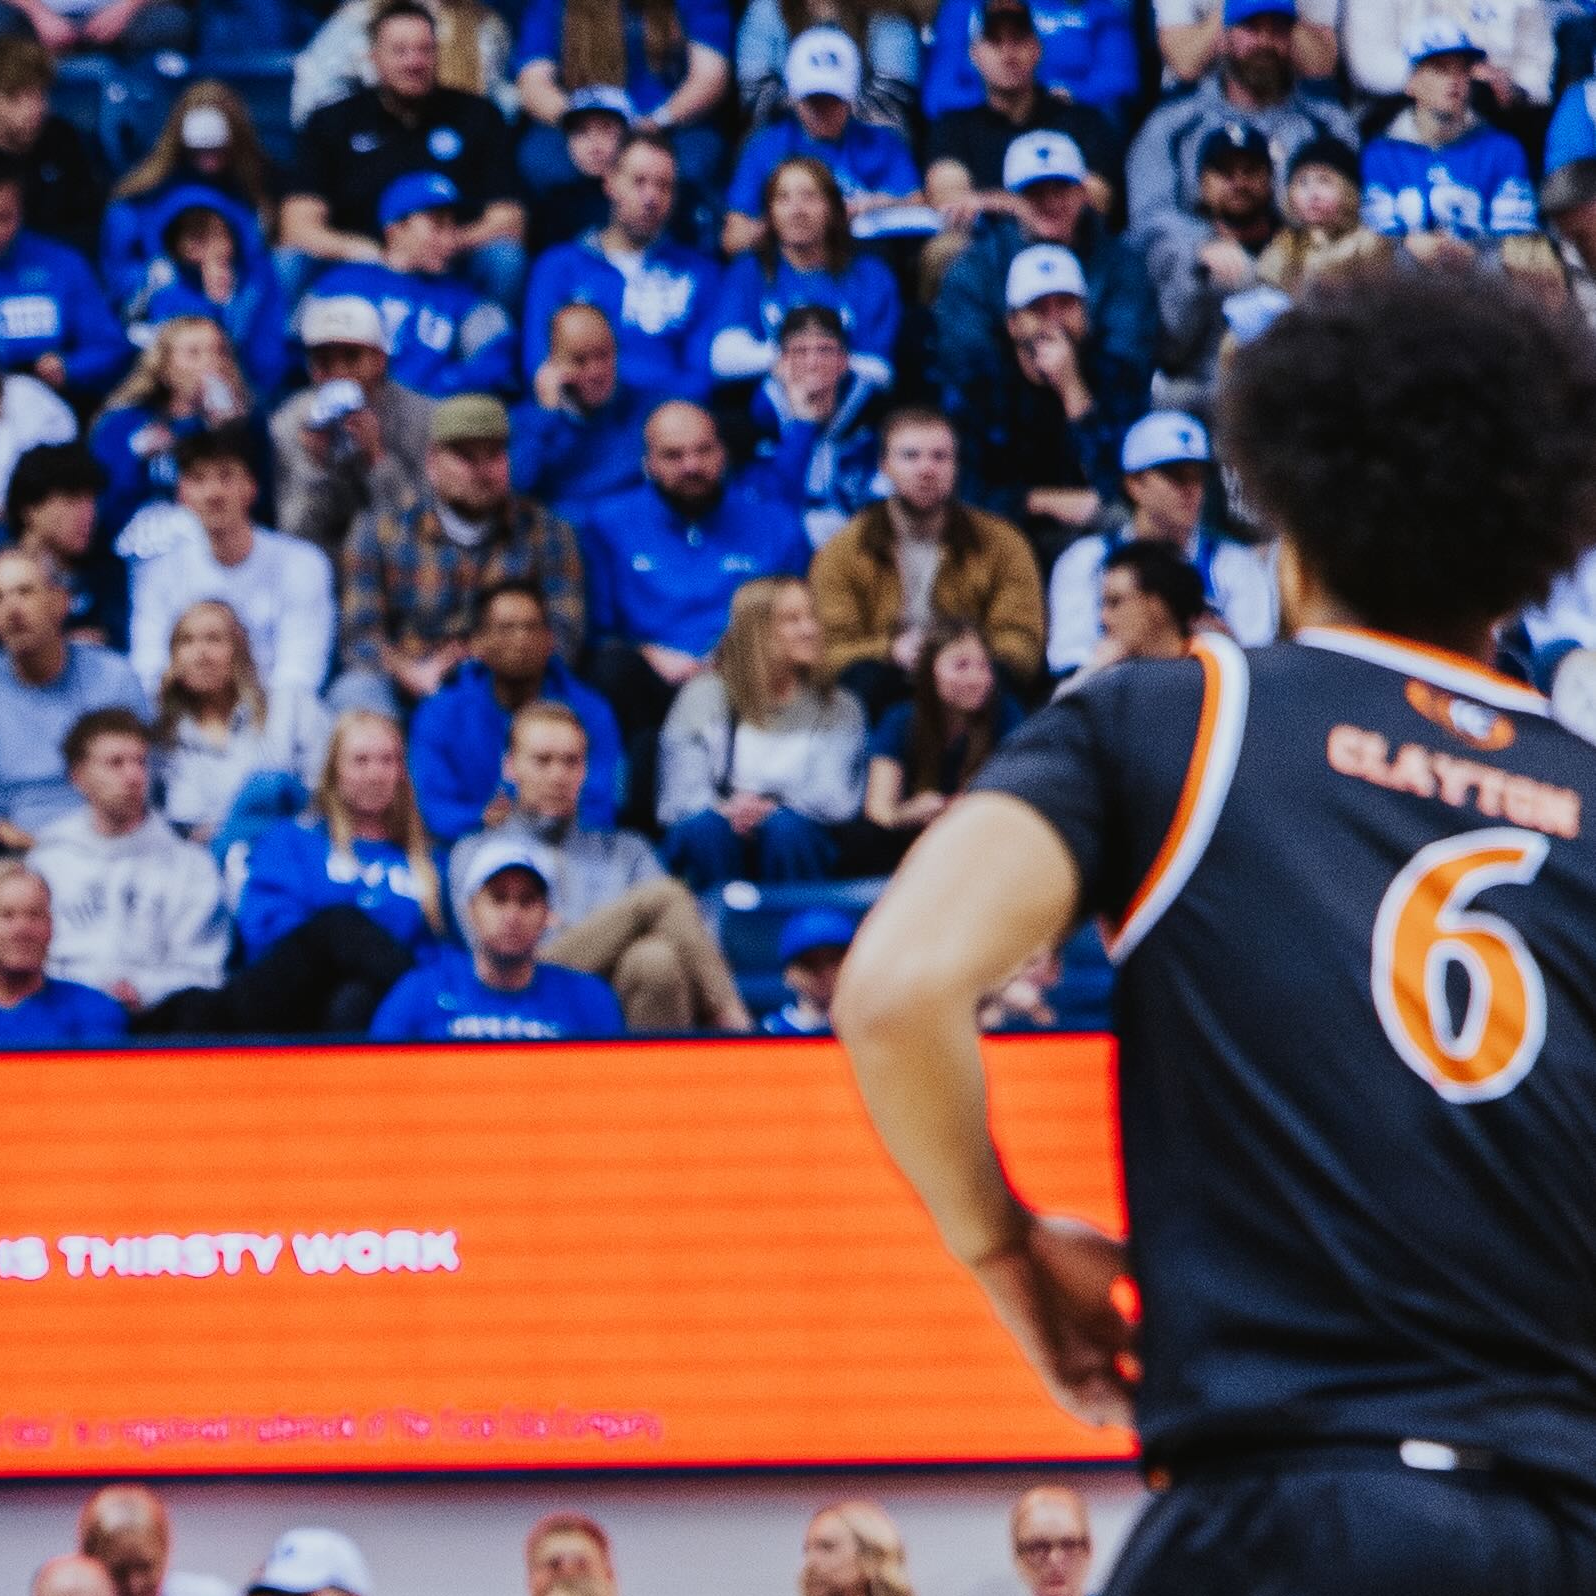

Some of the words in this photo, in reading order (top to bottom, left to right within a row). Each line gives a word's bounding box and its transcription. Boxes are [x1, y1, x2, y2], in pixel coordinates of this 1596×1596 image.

[1327, 723, 1580, 839] CLAYTON
[1371, 826, 1550, 1104] 6
[57, 1233, 283, 1278] THIRSTY
[291, 1229, 460, 1275] WORK
